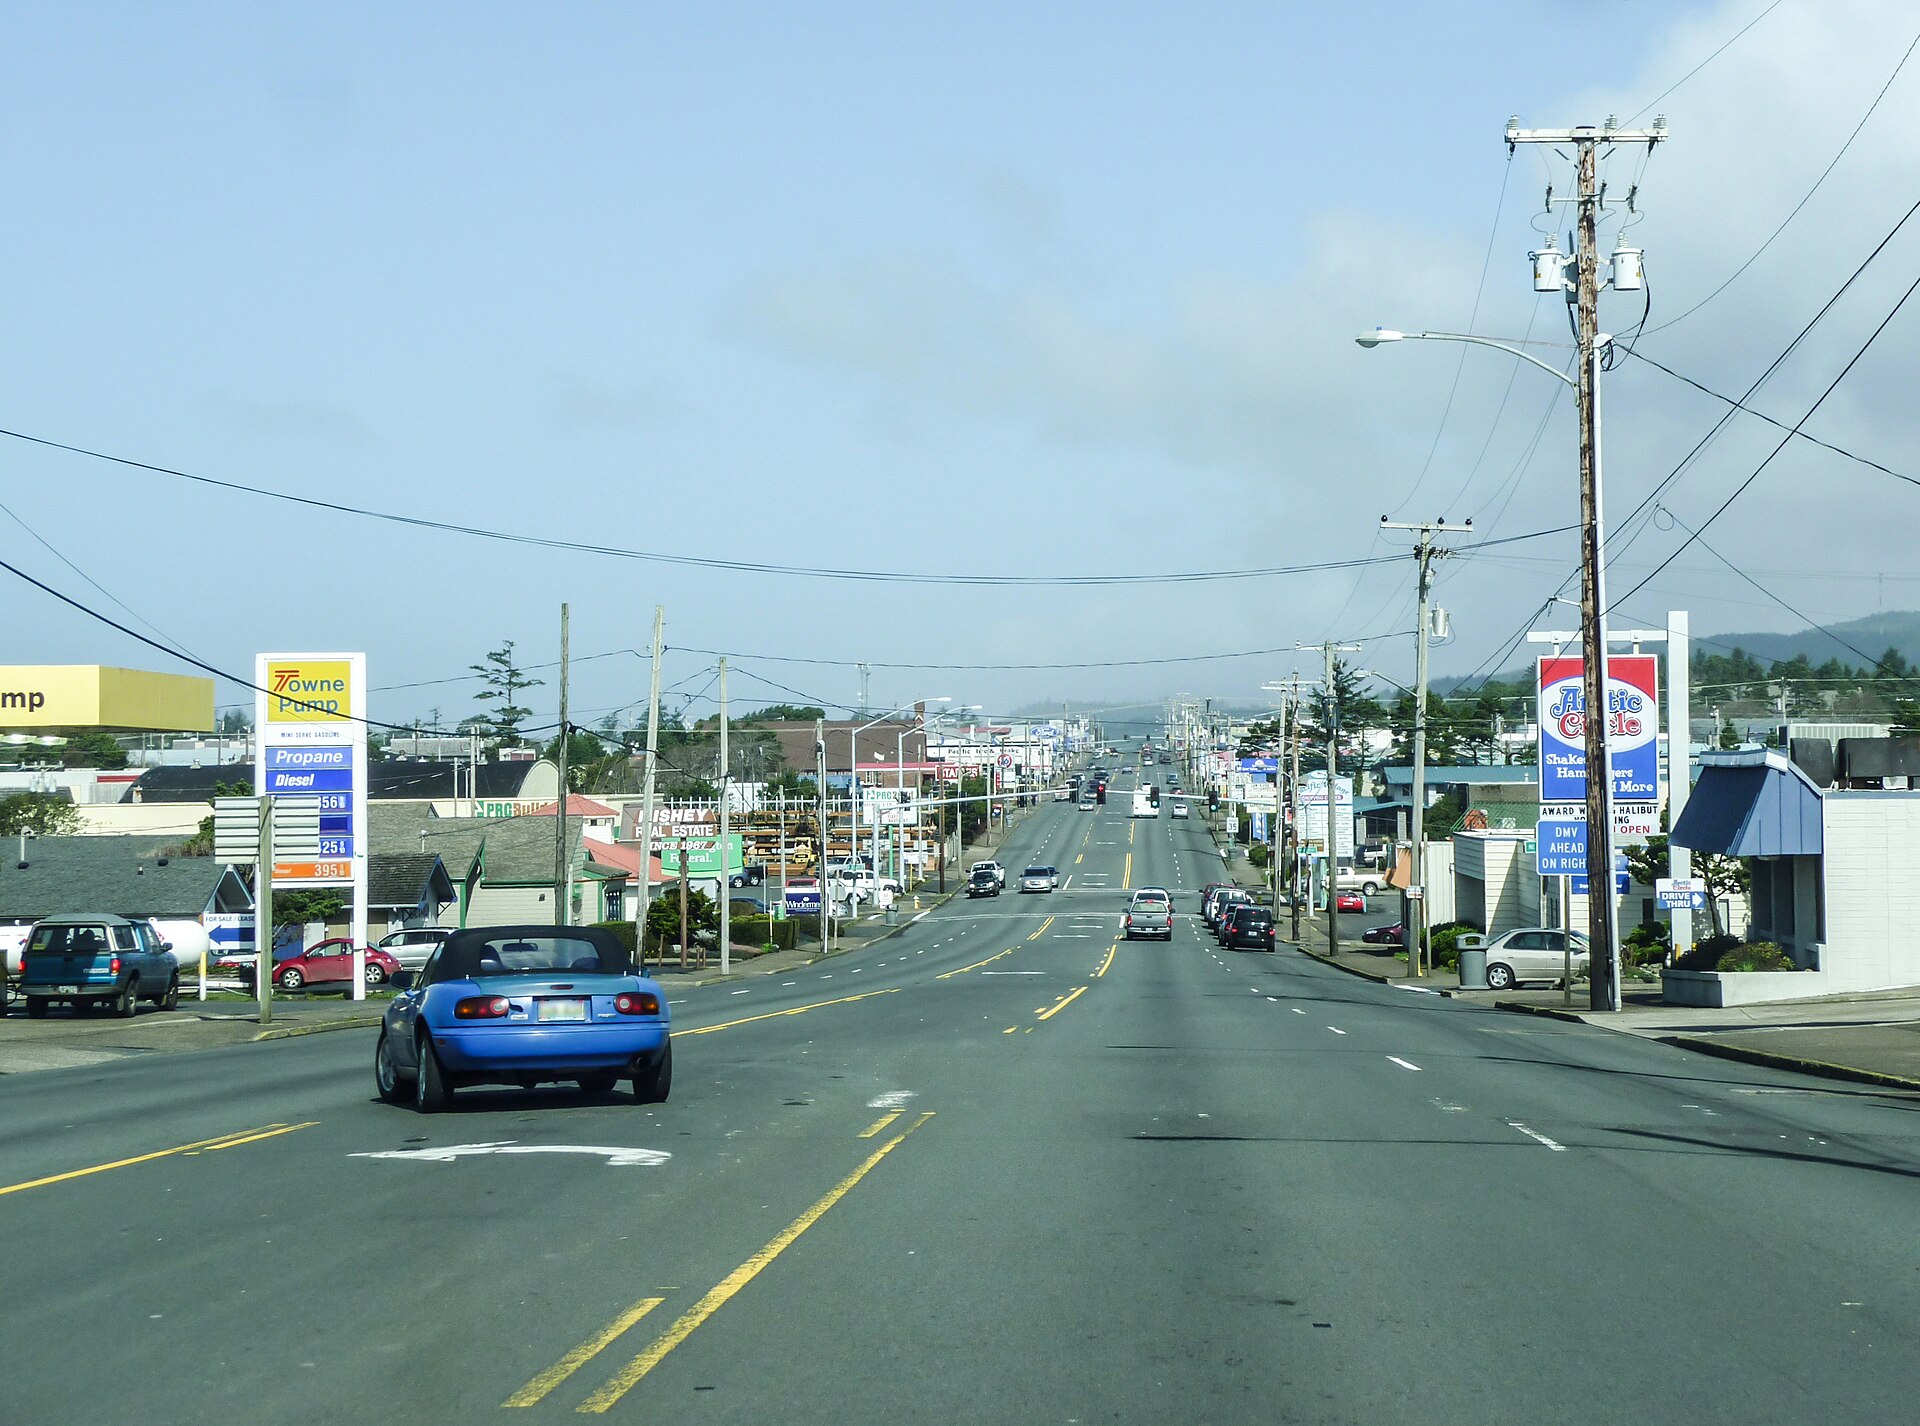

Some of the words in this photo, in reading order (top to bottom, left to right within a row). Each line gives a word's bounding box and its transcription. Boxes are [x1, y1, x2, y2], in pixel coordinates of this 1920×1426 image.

[274, 670, 345, 692] Towne
[279, 697, 339, 716] Pump
[1551, 687, 1642, 718] Atic
[1558, 712, 1642, 738] Cicle
[276, 750, 343, 766] Propane
[1546, 754, 1586, 764] Shake
[942, 767, 977, 777] TAES
[1557, 767, 1633, 780] Hamers
[275, 774, 315, 786] Diesel
[1620, 781, 1653, 792] More
[320, 796, 338, 808] 56
[487, 802, 548, 818] PROBuil
[638, 809, 709, 822] ISHEY
[1542, 807, 1574, 815] AWARD
[1619, 806, 1658, 815] HALIBUT
[1615, 816, 1629, 824] ING
[636, 826, 666, 837] RAL
[672, 825, 713, 836] ESTATE
[1555, 827, 1578, 838] DMV
[1620, 825, 1650, 833] OPEN
[319, 841, 338, 853] 25
[650, 841, 678, 850] INCE
[1550, 843, 1584, 853] AHEAD
[670, 853, 712, 863] Feeral.
[1542, 858, 1557, 868] ON
[1561, 858, 1588, 868] RIGH
[314, 864, 338, 876] 395
[1665, 900, 1690, 908] THRU
